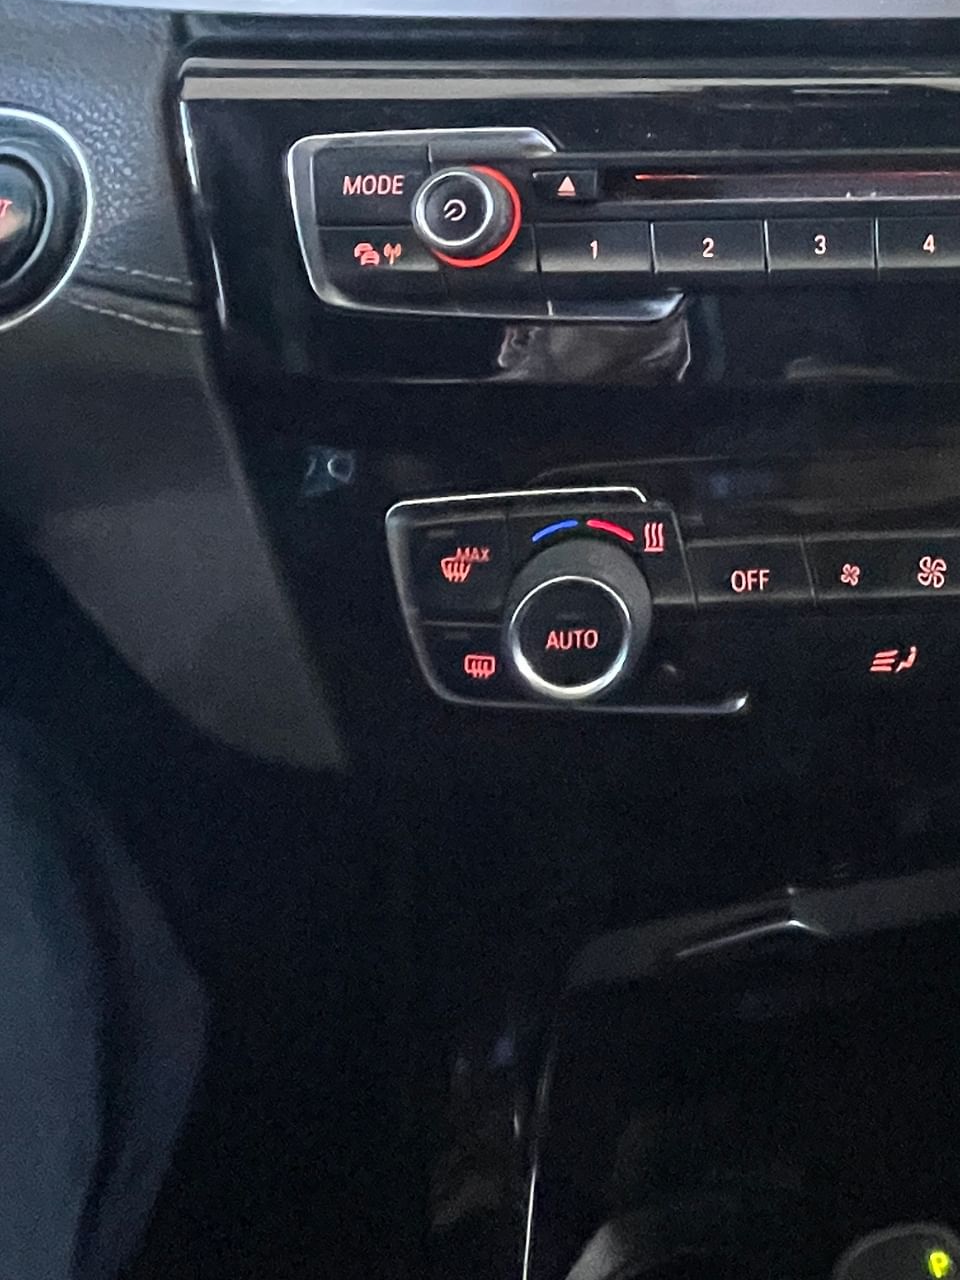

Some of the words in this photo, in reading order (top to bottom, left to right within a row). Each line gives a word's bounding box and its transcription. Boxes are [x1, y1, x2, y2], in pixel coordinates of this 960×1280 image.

[342, 174, 405, 196] MODE
[589, 239, 598, 259] 1
[702, 237, 715, 258] 2
[814, 234, 827, 255] 3
[922, 234, 936, 254] 4
[455, 547, 491, 564] MAX
[730, 569, 770, 593] OFF
[545, 629, 599, 650] AUTO
[927, 1250, 952, 1279] P
